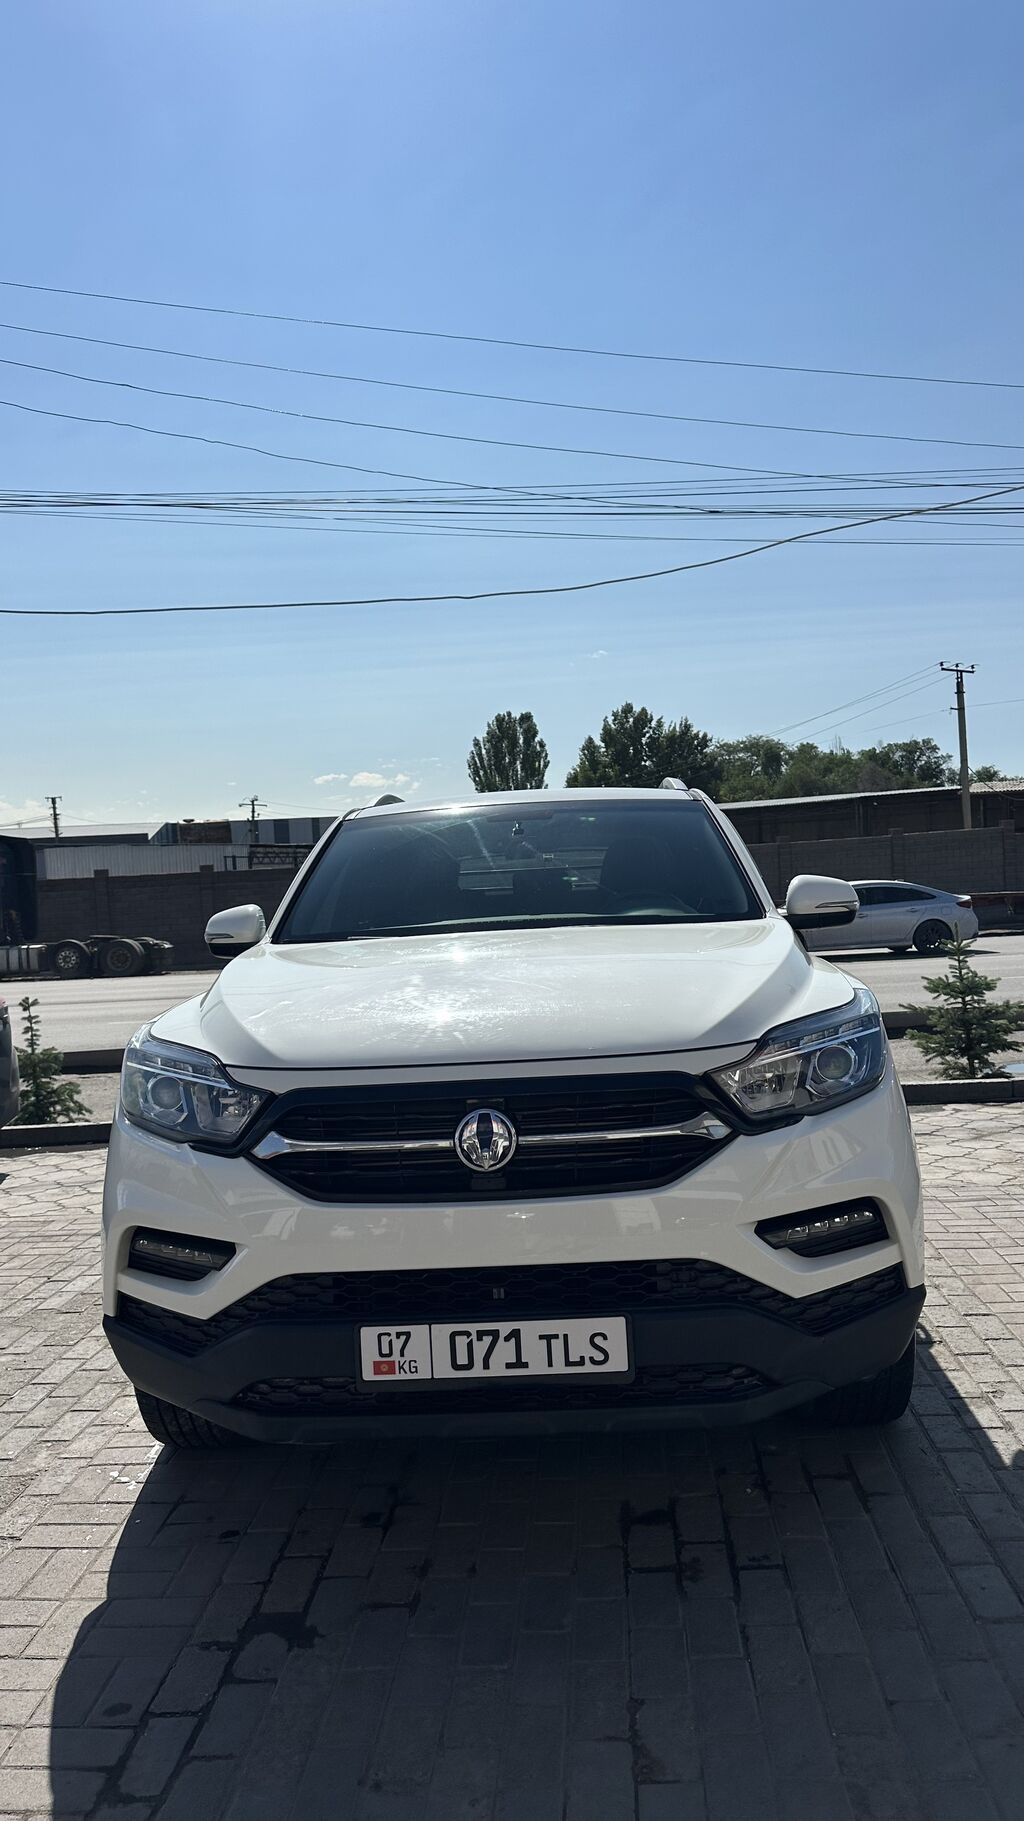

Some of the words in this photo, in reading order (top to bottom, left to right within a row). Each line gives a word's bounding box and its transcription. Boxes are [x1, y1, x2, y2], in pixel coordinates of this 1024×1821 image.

[377, 1331, 411, 1358] 07
[449, 1329, 529, 1371] 071
[538, 1332, 610, 1368] TLS
[398, 1360, 418, 1375] KG
